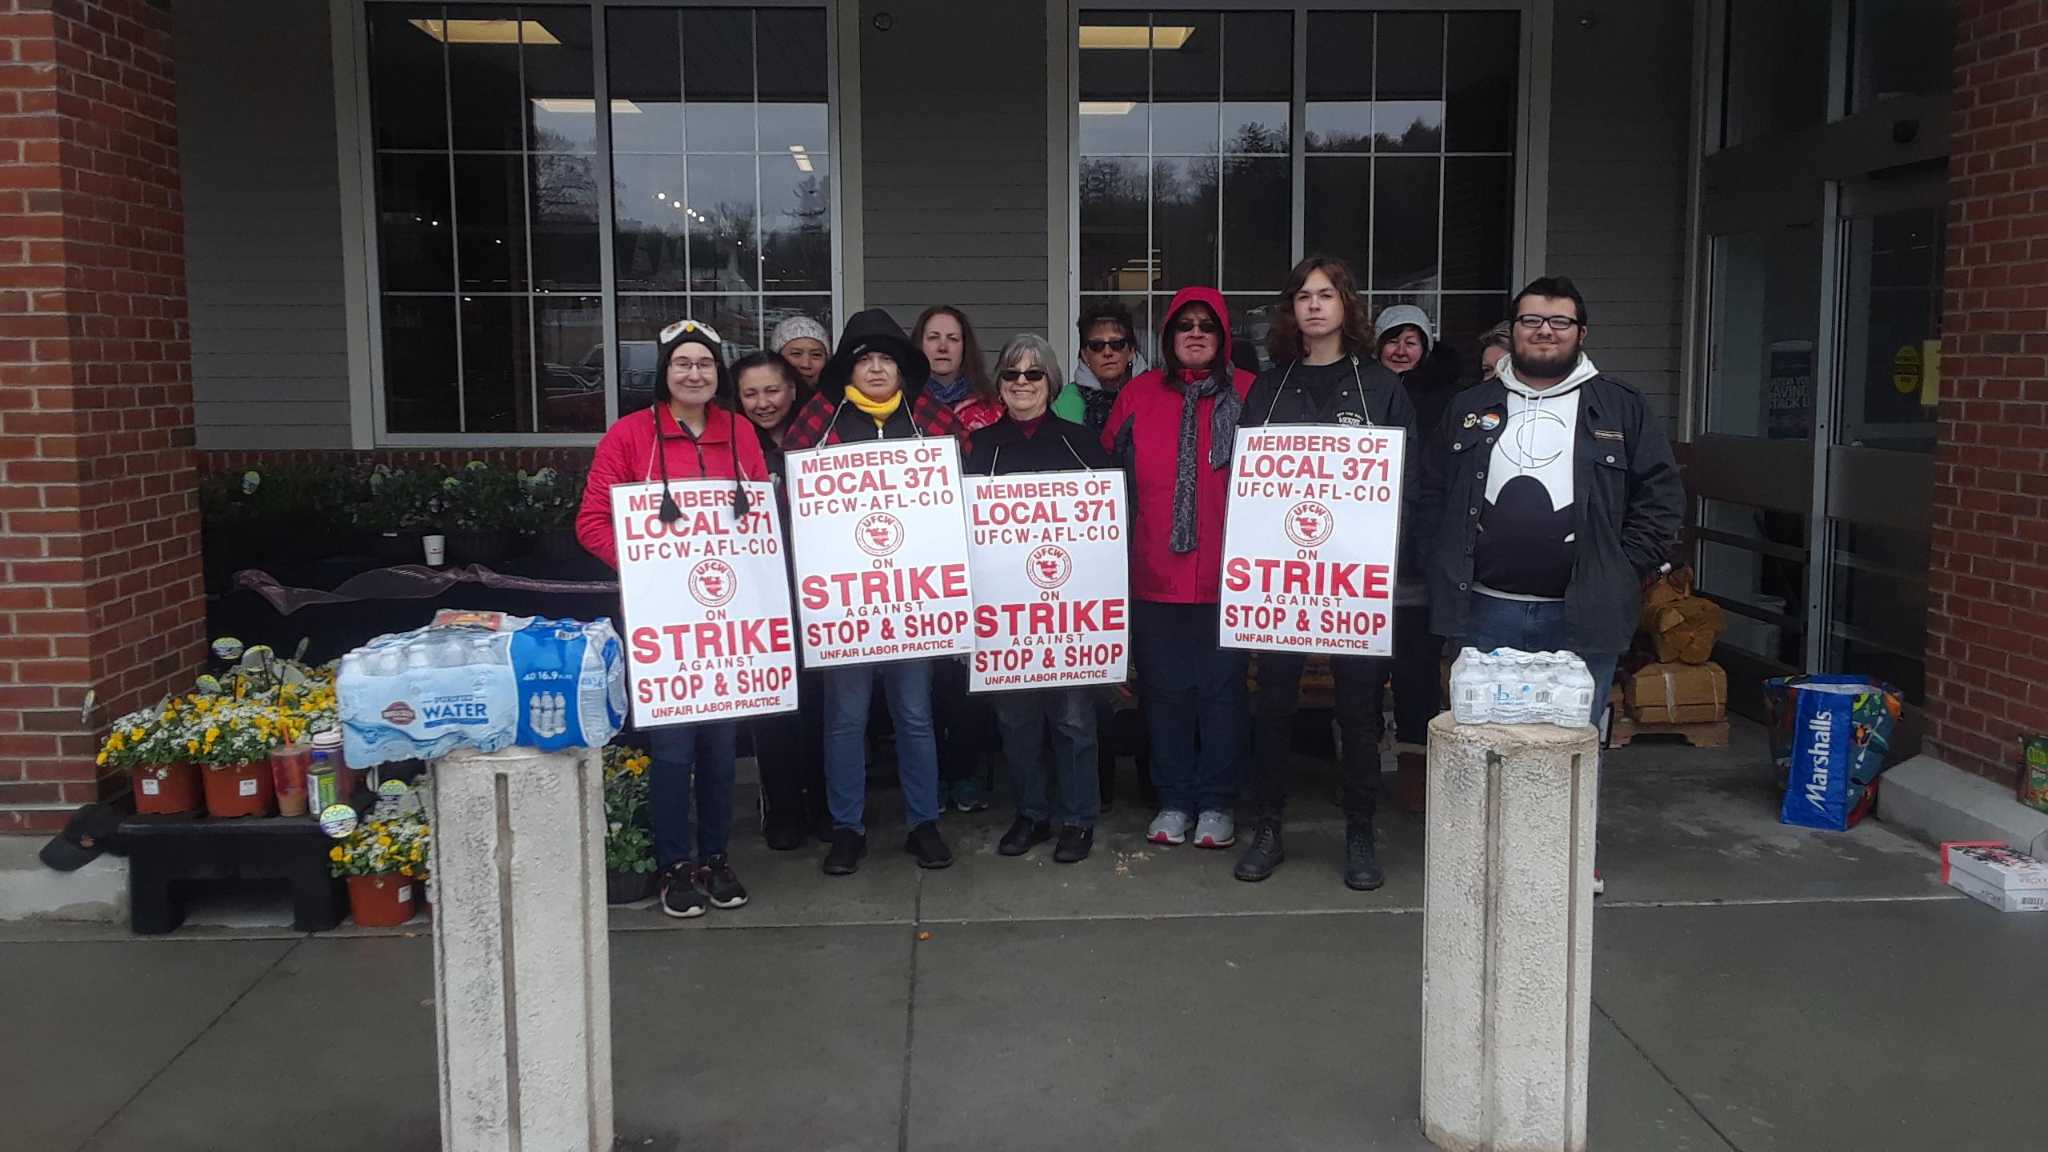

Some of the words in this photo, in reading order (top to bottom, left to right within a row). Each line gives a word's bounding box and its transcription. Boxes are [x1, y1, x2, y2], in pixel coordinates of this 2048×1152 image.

[1247, 435, 1351, 453] MEMBERS
[1357, 437, 1389, 454] OF
[801, 449, 908, 474] MEMBERS
[914, 447, 942, 463] OF
[1238, 454, 1335, 480] LOCAL
[1342, 457, 1390, 482] 371
[797, 469, 897, 499] LOCAL
[904, 466, 949, 489] 371
[976, 481, 1079, 500] MEMBERS
[1084, 480, 1112, 496] OF
[1237, 481, 1391, 502] UFCW-AFL-CIO
[748, 491, 765, 506] OF
[799, 489, 954, 517] UFCW-AFL-CIO
[972, 501, 1068, 526] LOCAL
[1074, 499, 1116, 522] 371
[1293, 504, 1327, 517] UFCW
[625, 511, 730, 540] LOCAL
[736, 511, 773, 535] 371
[862, 515, 896, 528] UFCW
[974, 525, 1120, 545] UFCW-AFL-CIO
[627, 538, 778, 562] UFCW-AFL-CIO
[1033, 548, 1064, 560] UFCW
[1296, 549, 1318, 561] ON
[696, 562, 729, 575] UFCW
[872, 558, 893, 570] ON
[801, 563, 968, 610] STRIKE
[1225, 557, 1389, 599] STRIKE
[1040, 590, 1060, 601] ON
[1263, 594, 1343, 608] AGAINST
[705, 609, 726, 621] ON
[845, 601, 925, 618] AGAINST
[973, 599, 1125, 638] STRIKE
[807, 619, 870, 647] STOP
[880, 617, 896, 641] &
[904, 611, 969, 638] SHOP
[1225, 604, 1286, 630] STOP
[1295, 608, 1311, 632] &
[1320, 609, 1387, 636] SHOP
[631, 617, 791, 664] STRIKE
[820, 646, 860, 660] UNFAIR
[862, 644, 899, 657] LABOR
[901, 639, 954, 652] PRACTICE
[1011, 633, 1085, 647] AGAINST
[1234, 632, 1273, 644] UNFAIR
[1275, 635, 1313, 647] LABOR
[1315, 637, 1369, 650] PRACTICE
[678, 656, 755, 672] AGAINST
[975, 648, 1034, 673] STOP
[1042, 647, 1056, 669] &
[1064, 643, 1123, 668] SHOP
[637, 674, 703, 704] STOP
[714, 672, 730, 696] &
[736, 666, 792, 694] SHOP
[985, 674, 1021, 686] UNFAIR
[1023, 672, 1058, 683] LABOR
[1060, 669, 1108, 681] PRACTICE
[422, 703, 487, 719] WATER
[651, 705, 693, 718] UNFAIR
[696, 701, 733, 714] LABOR
[735, 696, 781, 711] PRACTICE
[1805, 710, 1832, 813] Marshalls
